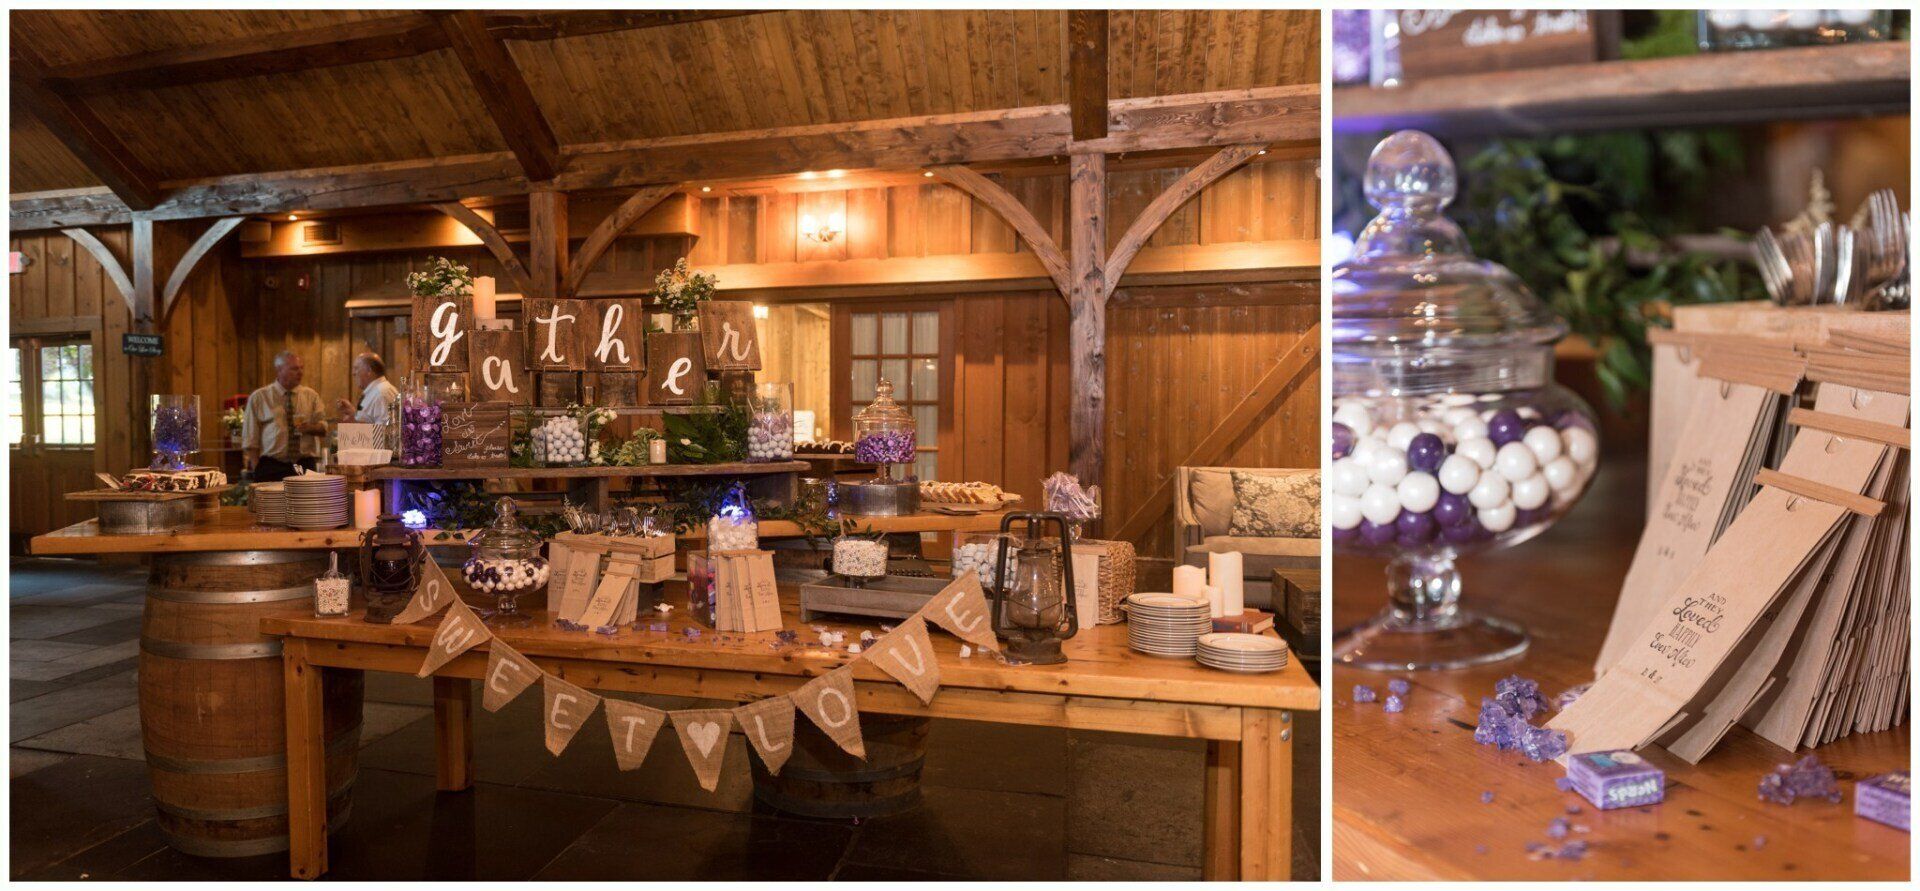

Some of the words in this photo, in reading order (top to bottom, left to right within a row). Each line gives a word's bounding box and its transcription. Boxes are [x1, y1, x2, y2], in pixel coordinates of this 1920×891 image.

[127, 336, 160, 345] WELCOME
[1672, 597, 1724, 634] Loved
[1699, 597, 1724, 616] THEY
